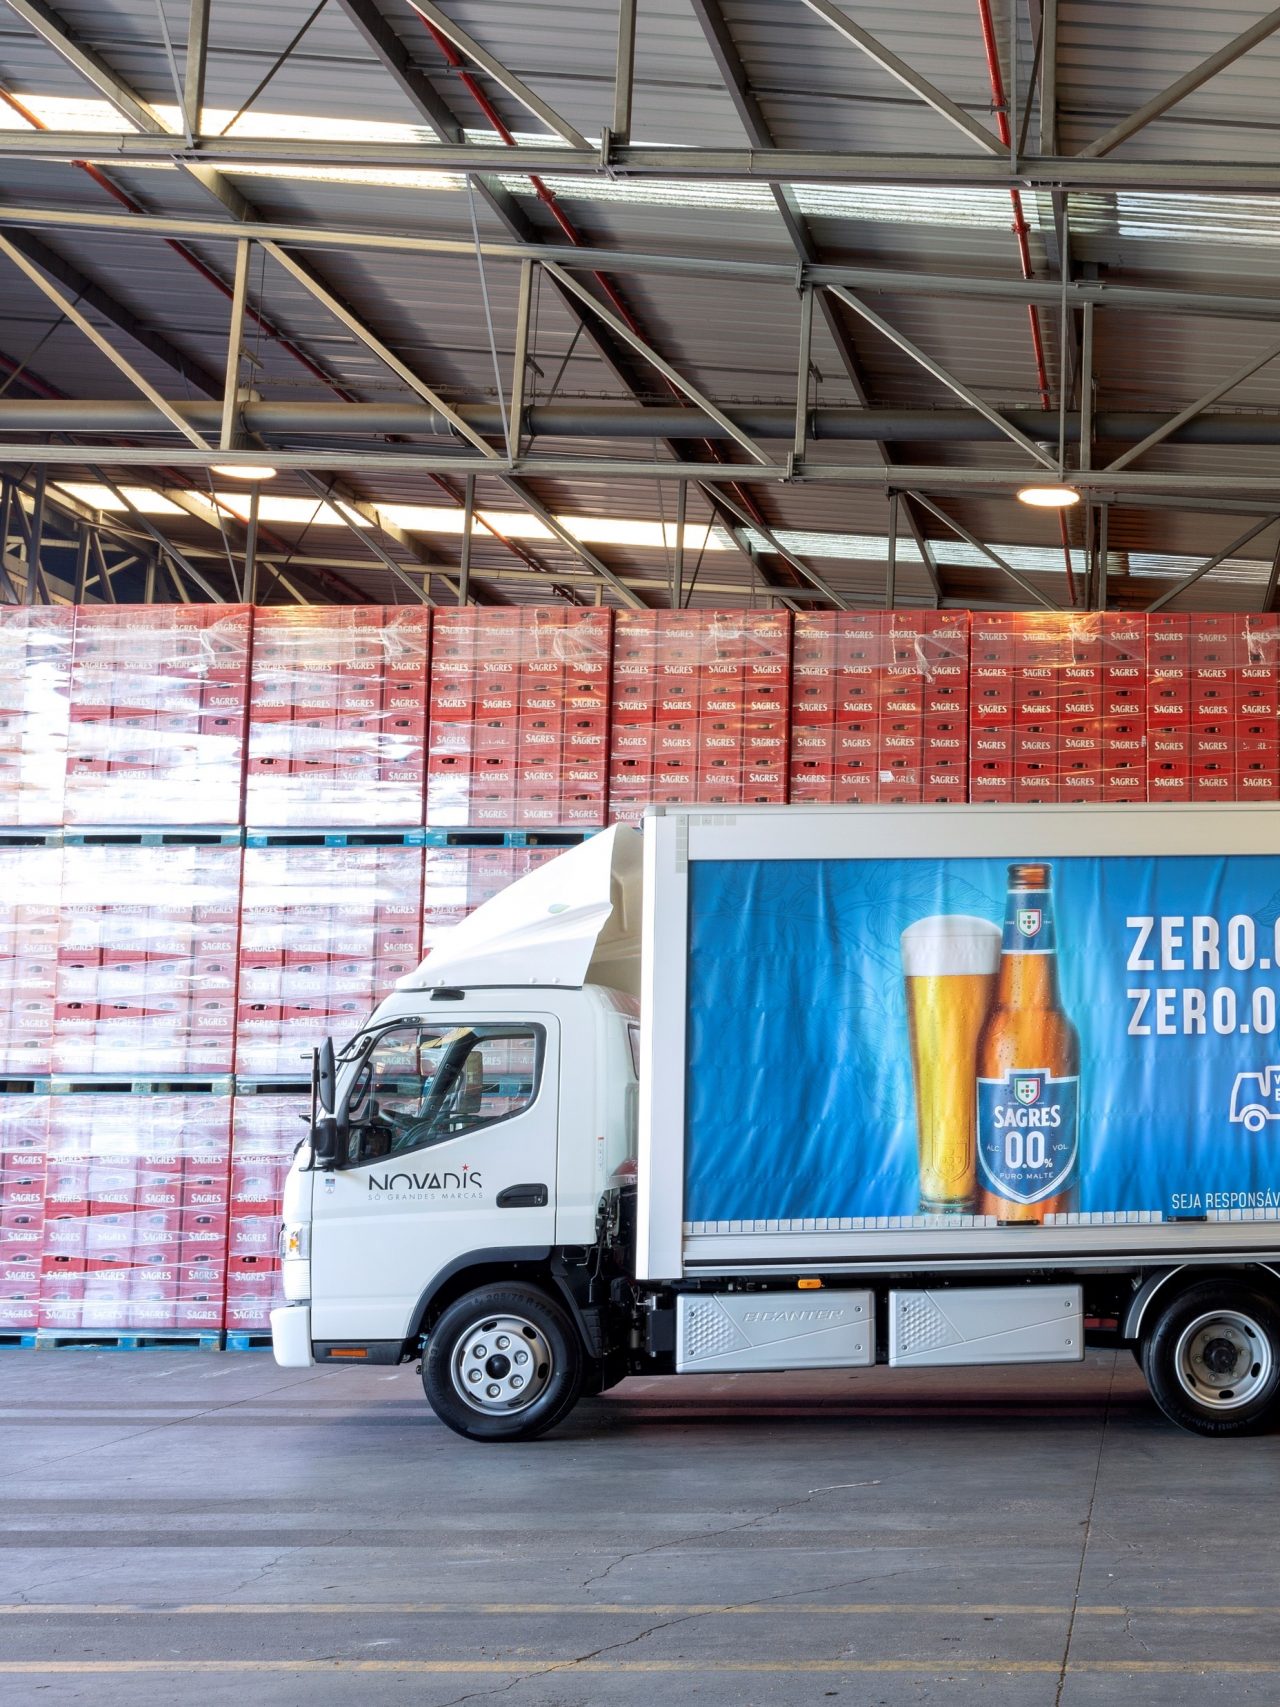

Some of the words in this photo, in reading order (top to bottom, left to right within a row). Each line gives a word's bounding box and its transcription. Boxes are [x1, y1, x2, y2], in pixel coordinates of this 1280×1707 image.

[209, 696, 239, 706] SAGRES
[482, 699, 512, 709] SAGRES
[526, 699, 556, 708] SAGRES
[662, 700, 692, 710] SAGRES
[706, 701, 736, 710] SAGRES
[843, 702, 873, 711] SAGRES
[886, 702, 916, 711] SAGRES
[1021, 704, 1051, 714] SAGRES
[1065, 703, 1094, 713] SAGRES
[1198, 705, 1228, 714] SAGRES
[1241, 704, 1271, 714] SAGRES
[525, 734, 555, 743] SAGRES
[662, 738, 691, 747] SAGRES
[706, 737, 735, 747] SAGRES
[751, 737, 780, 747] SAGRES
[842, 738, 871, 748] SAGRES
[885, 737, 915, 747] SAGRES
[930, 738, 960, 748] SAGRES
[977, 740, 1006, 750] SAGRES
[1021, 740, 1051, 750] SAGRES
[1110, 740, 1139, 749] SAGRES
[1154, 741, 1184, 751] SAGRES
[1198, 741, 1228, 750] SAGRES
[479, 772, 509, 782] SAGRES
[569, 770, 598, 780] SAGRES
[660, 774, 689, 784] SAGRES
[749, 773, 779, 783] SAGRES
[930, 775, 959, 784] SAGRES
[977, 776, 1006, 786] SAGRES
[1110, 776, 1139, 786] SAGRES
[1198, 777, 1228, 787] SAGRES
[478, 809, 508, 819] SAGRES
[523, 809, 553, 819] SAGRES
[201, 941, 231, 951] SAGRES
[19, 1018, 49, 1028] SAGRES
[198, 1017, 227, 1026] SAGRES
[994, 1104, 1061, 1128] SAGRES
[13, 1155, 42, 1165] SAGRES
[368, 1171, 482, 1190] NOVADIS
[1000, 1172, 1023, 1180] PURO
[1026, 1171, 1054, 1179] MALTE
[10, 1193, 40, 1202] SAGRES
[191, 1193, 221, 1203] SAGRES
[441, 1191, 483, 1199] MARCAS
[1171, 1193, 1201, 1209] SEJA
[188, 1231, 220, 1241] SAGRES
